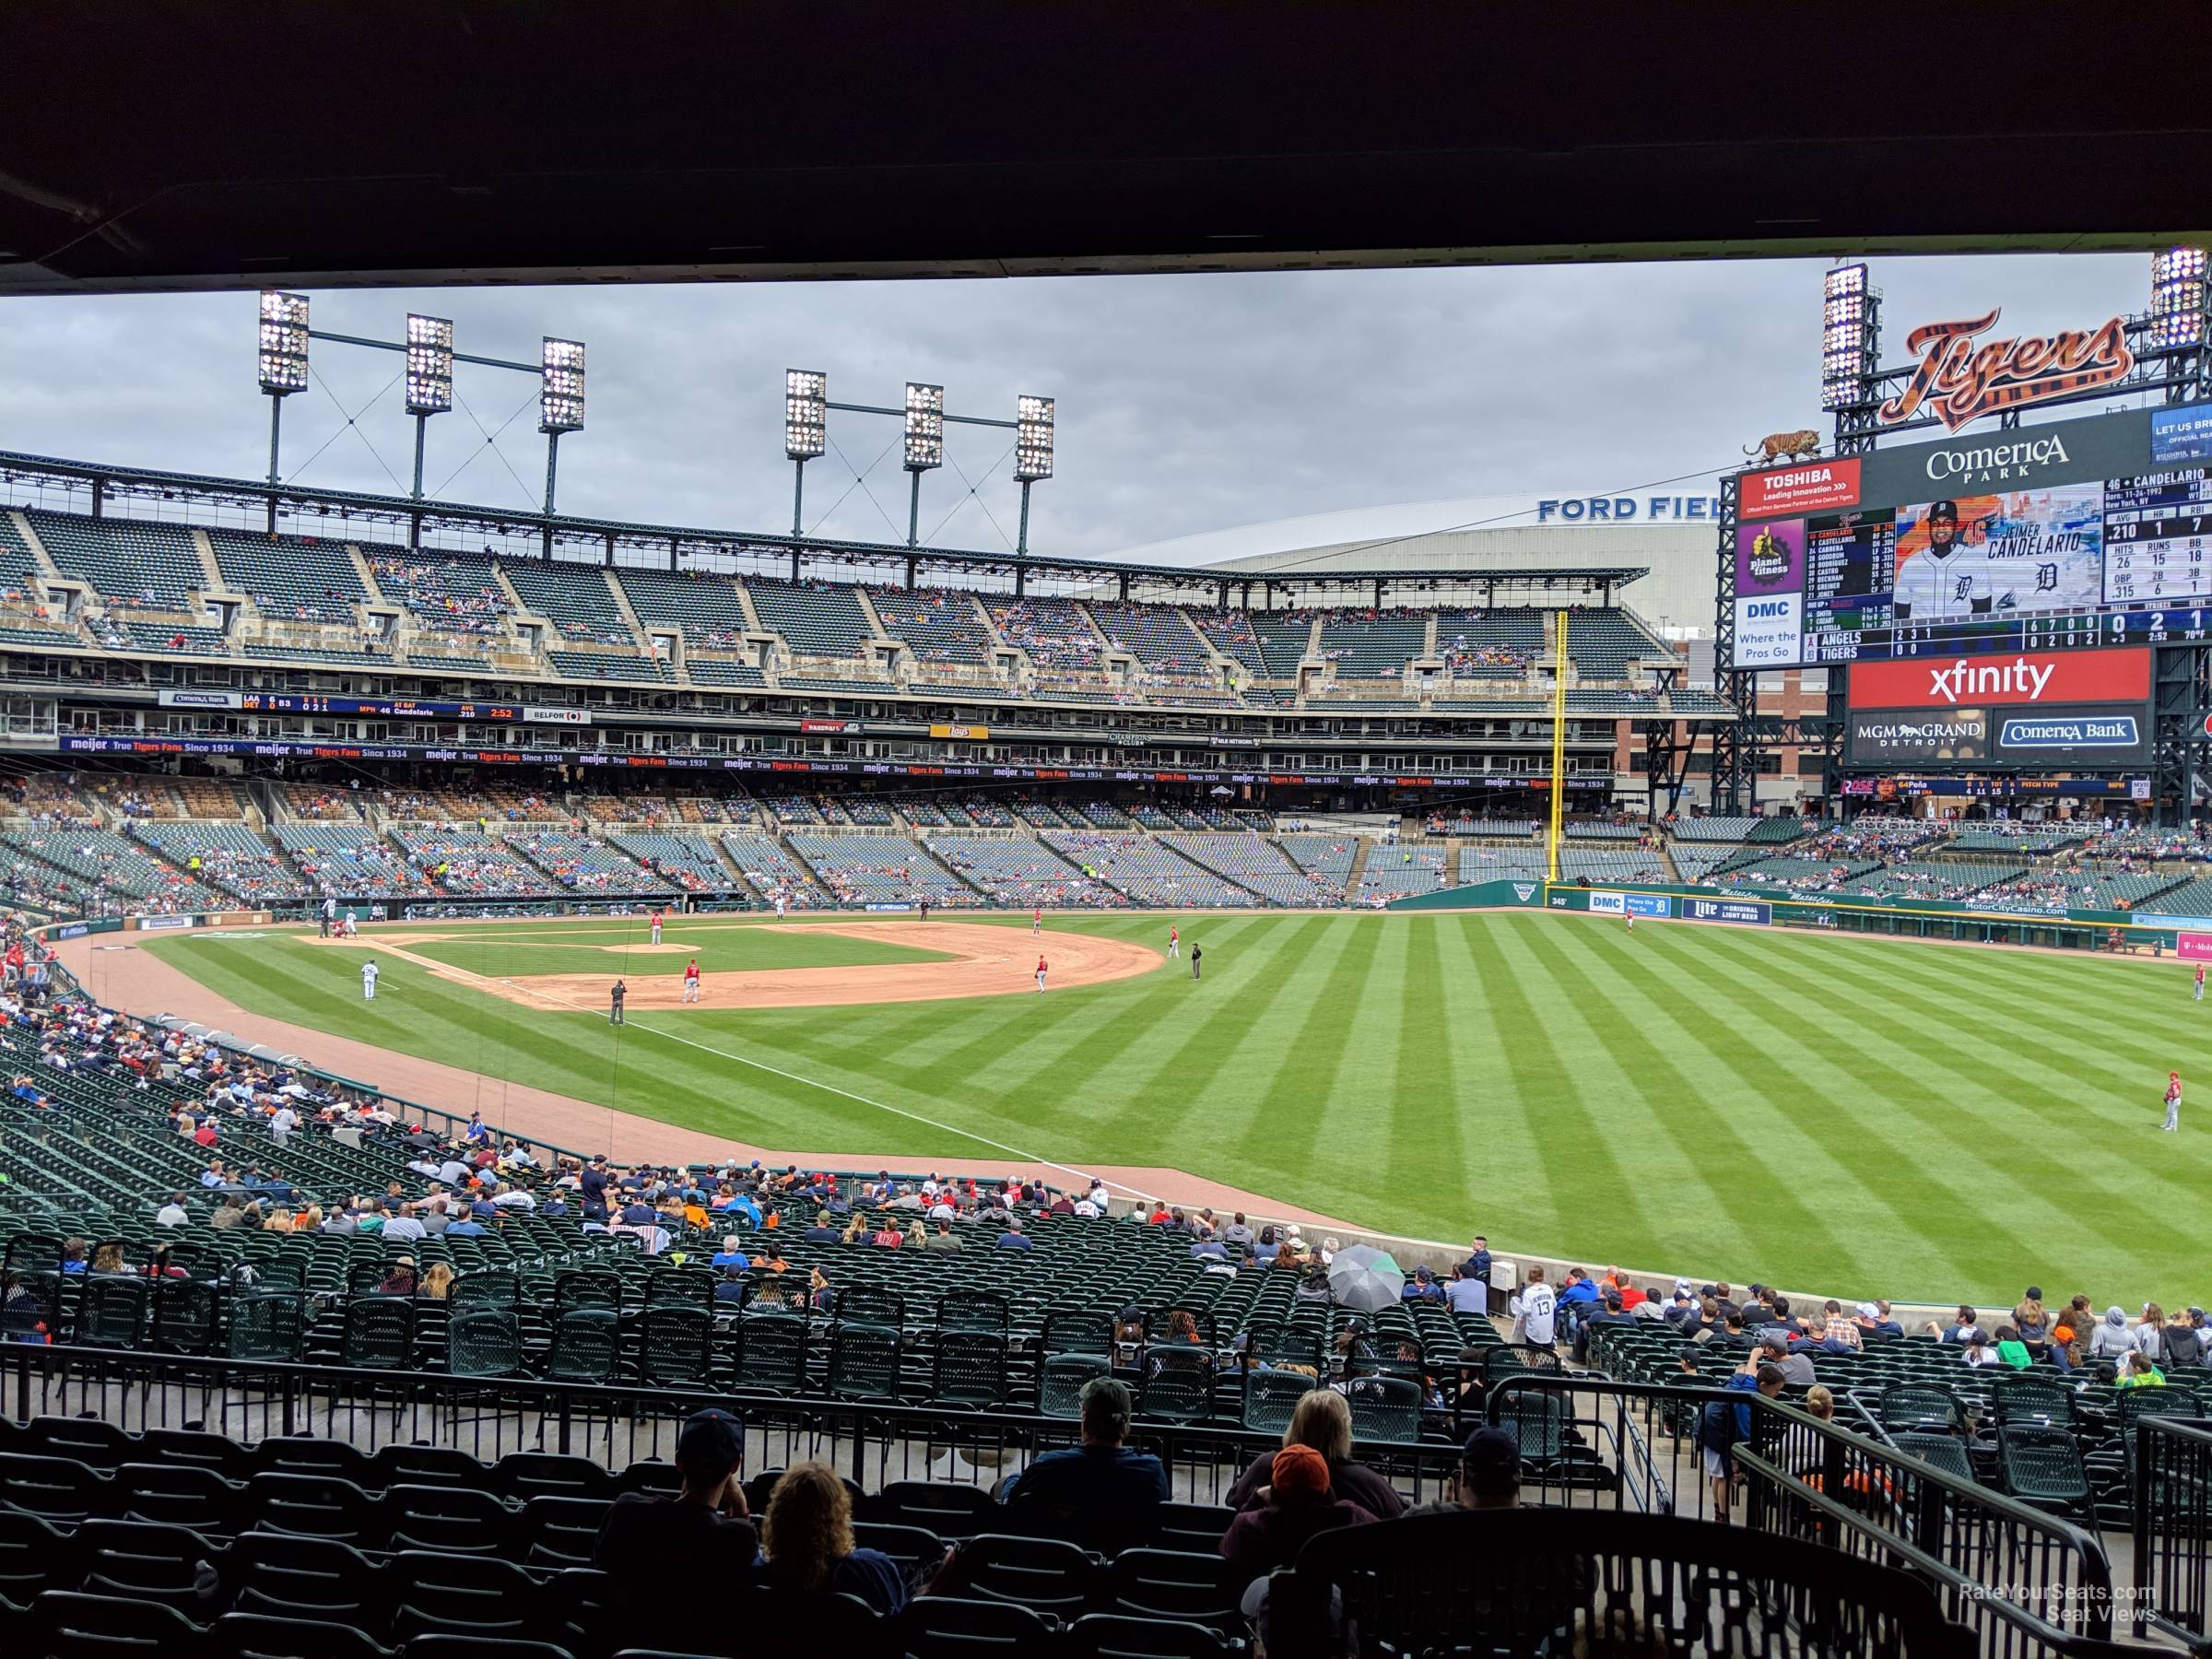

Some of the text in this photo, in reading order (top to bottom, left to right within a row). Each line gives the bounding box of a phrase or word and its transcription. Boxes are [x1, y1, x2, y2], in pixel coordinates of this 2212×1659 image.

[1880, 307, 2133, 433] Tigers
[2156, 422, 2191, 435] LET US
[2170, 435, 2198, 443] OFFICIAL
[1926, 435, 2070, 479] Comerica
[1764, 468, 1832, 490] TOSHIBA
[1964, 465, 2030, 484] PARK
[2107, 468, 2205, 490] 46 CANDELARIO
[1764, 485, 1832, 501] Leading Innovation
[2125, 487, 2162, 498] 11-24-1993
[1537, 496, 1721, 523] FORD FIEL
[2122, 500, 2138, 508] York,
[2191, 505, 2205, 514] RBI
[1963, 521, 1987, 546] 46
[2002, 524, 2041, 540] JEIMER
[2108, 517, 2201, 540] .210 1 7
[1818, 535, 1856, 546] CASTELLANOS
[1988, 532, 2081, 559] CANDELARIO
[2114, 538, 2201, 555] HITS RUNS BB
[1818, 545, 1843, 553] CABRERA
[1818, 552, 1844, 560] GOODRUM
[1750, 557, 1783, 570] planet
[2117, 550, 2201, 568] 26 15 18
[1754, 565, 1788, 575] fitness
[2114, 568, 2199, 582] OBP 2B 3B
[1818, 574, 1843, 582] BECKHAM
[1818, 590, 1834, 598] JONES
[2112, 583, 2160, 597] .315 6
[1747, 601, 1789, 618] DMC
[2145, 602, 2171, 610] STRIKES
[2112, 610, 2201, 632] 0 2 1
[1739, 631, 1796, 644] Where the
[1821, 618, 2093, 645] ANGELS 2 3 1 6 7 0 0
[2149, 629, 2205, 641] 2:52 70°F
[1746, 647, 1788, 658] Pros Go
[1821, 632, 2093, 660] TIGERS 0 0 0 2 0 2
[1929, 657, 2055, 702] xfinity
[394, 708, 433, 716] Candelario
[490, 709, 512, 718] 2:52
[951, 726, 970, 735] Lay's
[1858, 722, 1980, 739] MGM GRAND
[2010, 722, 2127, 743] Comerica Bank
[72, 737, 107, 751] meijer
[114, 742, 131, 750] True
[134, 743, 159, 752] Tigers
[185, 744, 208, 752] Since
[1880, 738, 1956, 747] DETROIT
[255, 744, 289, 756] meijer
[314, 747, 339, 758] Tigers
[341, 748, 359, 757] Fans
[362, 749, 383, 758] Since
[387, 749, 406, 758] 1934
[580, 754, 607, 765] meijer
[629, 758, 649, 767] Tigers
[994, 768, 1018, 778] meijer
[1036, 770, 1053, 779] Tigers
[1354, 775, 1379, 786] meijer
[1397, 778, 1416, 786] Tigers
[1594, 897, 1621, 909] DMC
[1694, 901, 1718, 918] Lite
[1965, 903, 2066, 914] MotorCityCasino.com
[1537, 1301, 1550, 1316] 13
